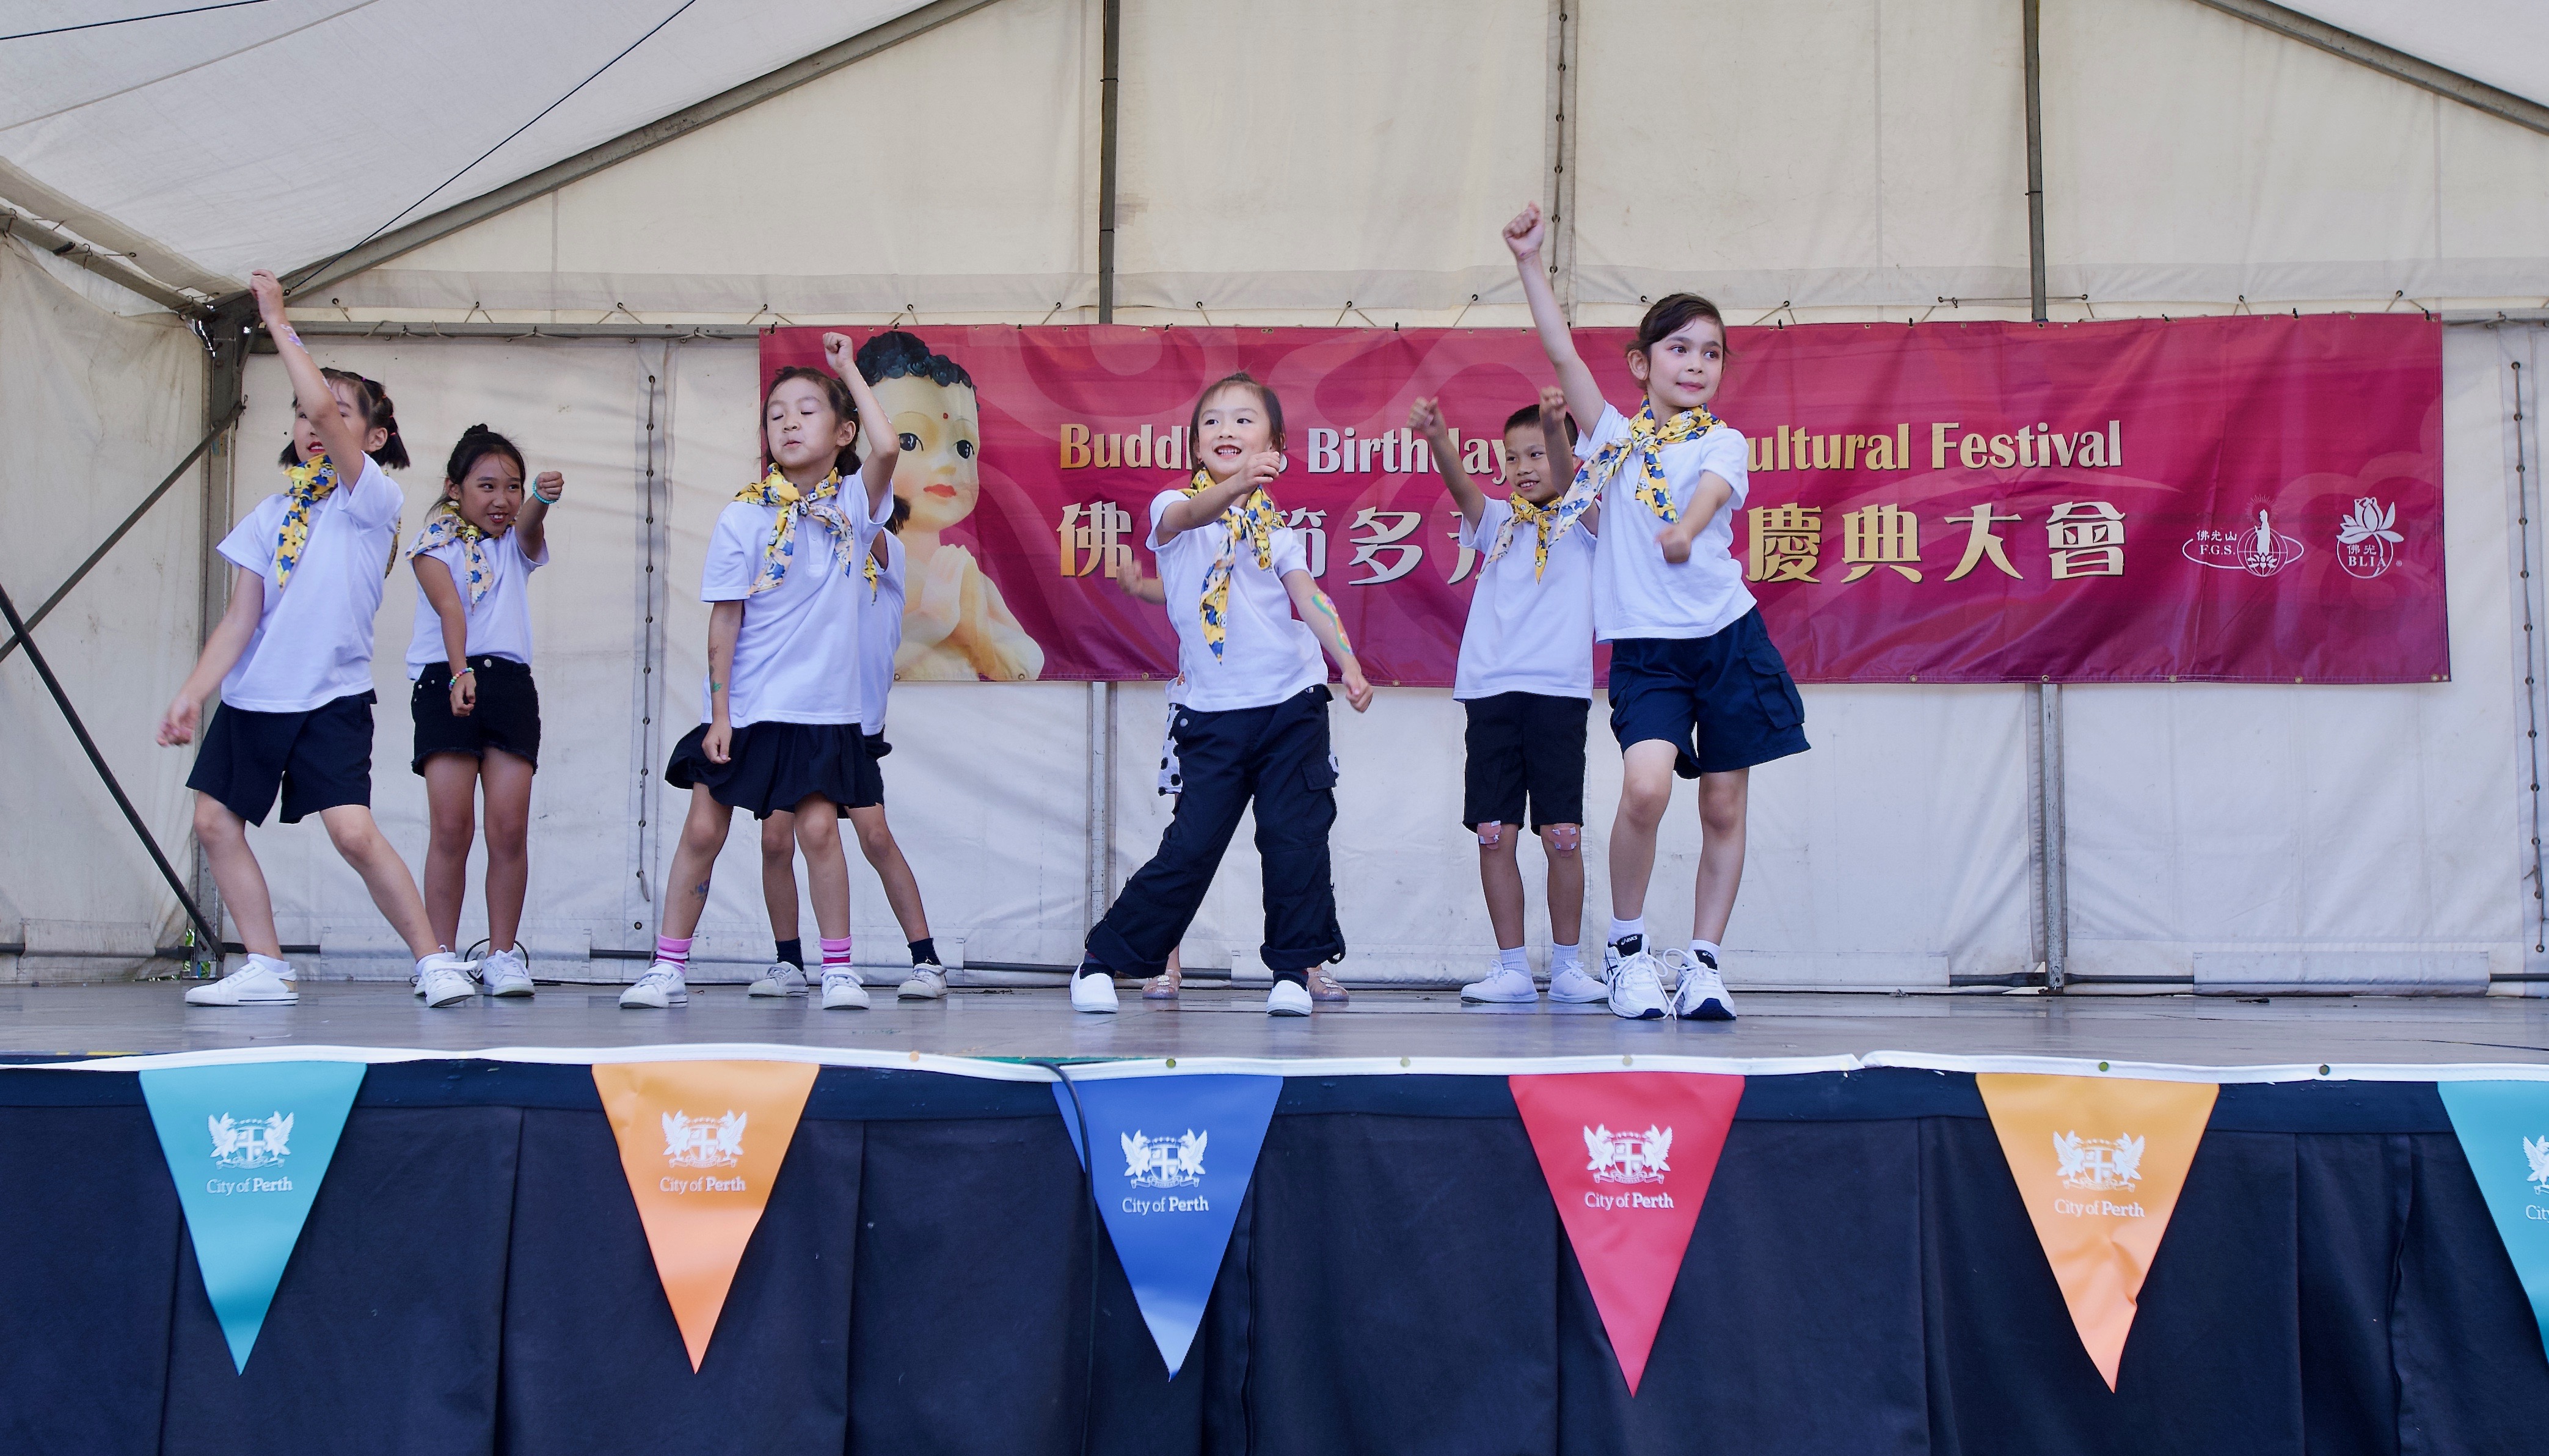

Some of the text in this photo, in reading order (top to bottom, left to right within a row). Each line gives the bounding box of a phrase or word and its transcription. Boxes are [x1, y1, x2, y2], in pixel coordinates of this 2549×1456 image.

[1931, 420, 2122, 470] Festival
[2196, 530, 2237, 542] 佛光山
[2199, 544, 2236, 556] F.G.S.
[2346, 544, 2377, 556] 佛光
[2347, 556, 2387, 567] BLIA
[206, 1176, 293, 1196] City of Perth
[659, 1176, 746, 1195] City of Perth
[1121, 1195, 1209, 1216] City of Perth
[1584, 1192, 1674, 1211] City of Perth
[2053, 1198, 2145, 1218] City of Perth
